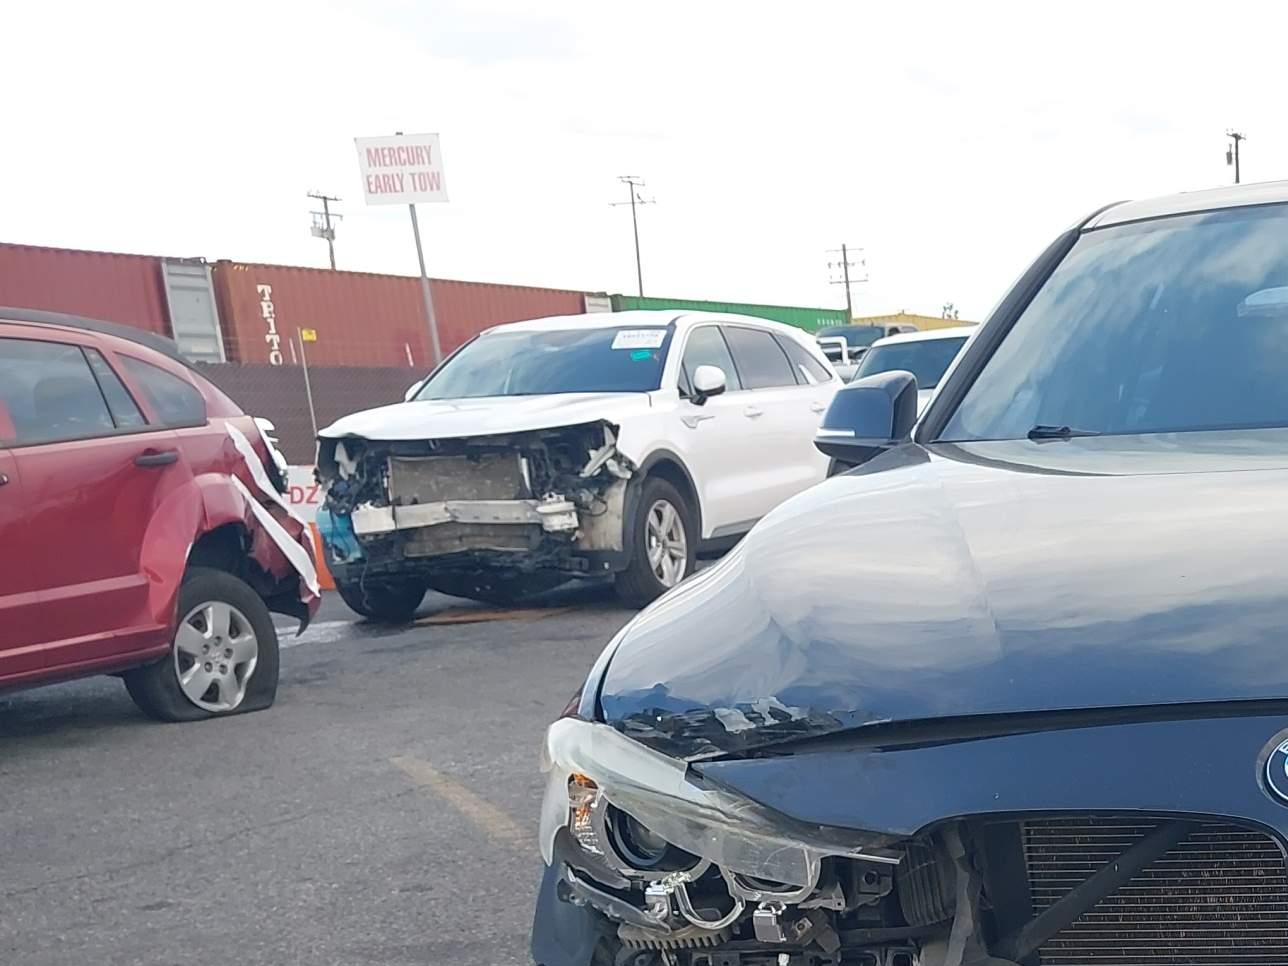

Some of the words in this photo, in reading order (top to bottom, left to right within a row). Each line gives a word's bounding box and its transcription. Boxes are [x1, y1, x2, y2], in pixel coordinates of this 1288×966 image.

[366, 145, 431, 168] MERCURY
[366, 173, 404, 194] EARLY
[409, 171, 441, 192] TOW
